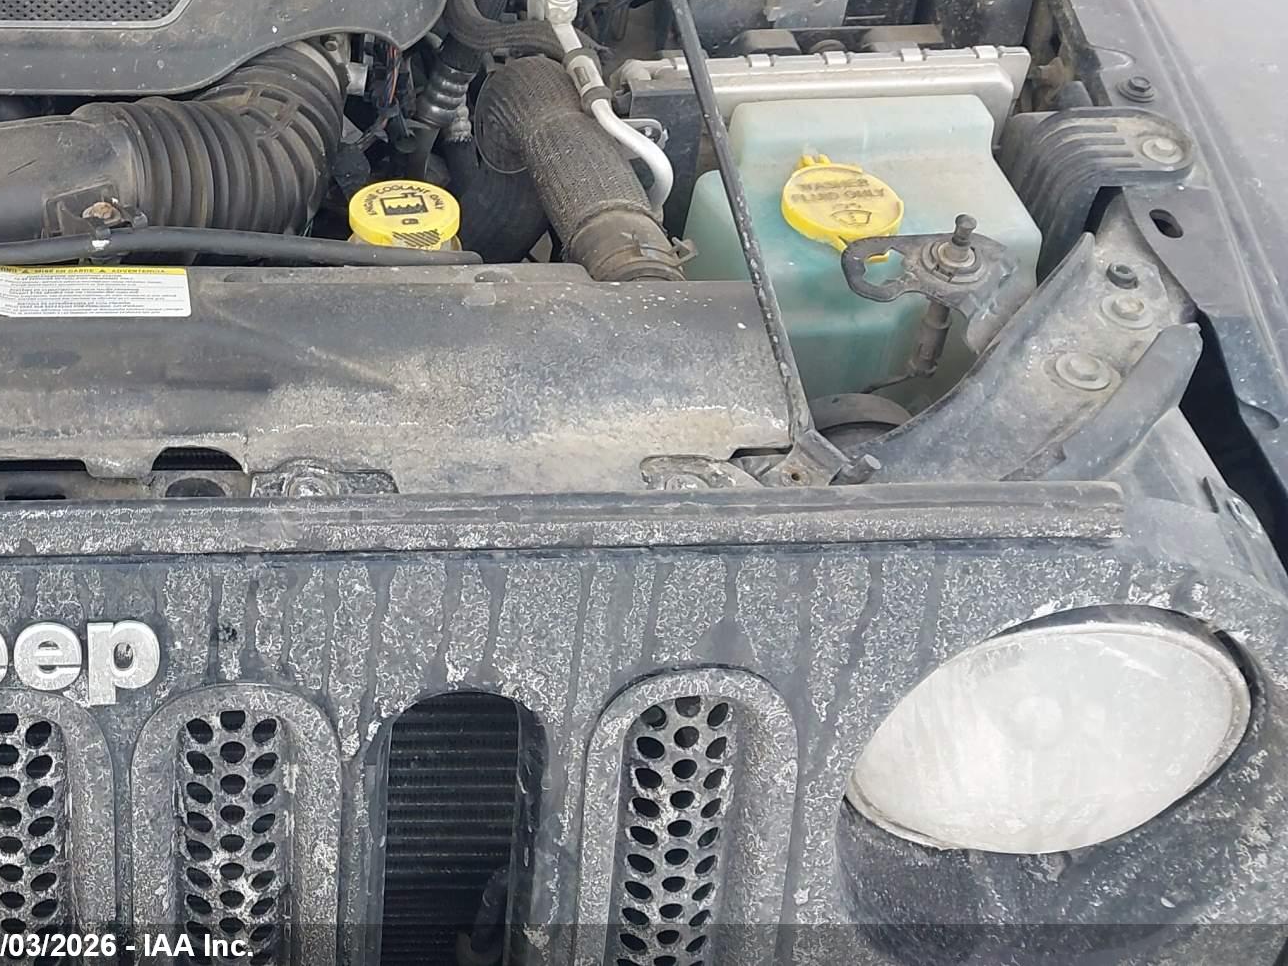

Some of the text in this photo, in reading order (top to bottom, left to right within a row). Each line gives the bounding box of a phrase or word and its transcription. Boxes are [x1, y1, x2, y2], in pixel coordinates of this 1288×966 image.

[376, 184, 431, 195] COOLANT
[430, 194, 446, 211] ONLY
[844, 188, 885, 200] ONLY
